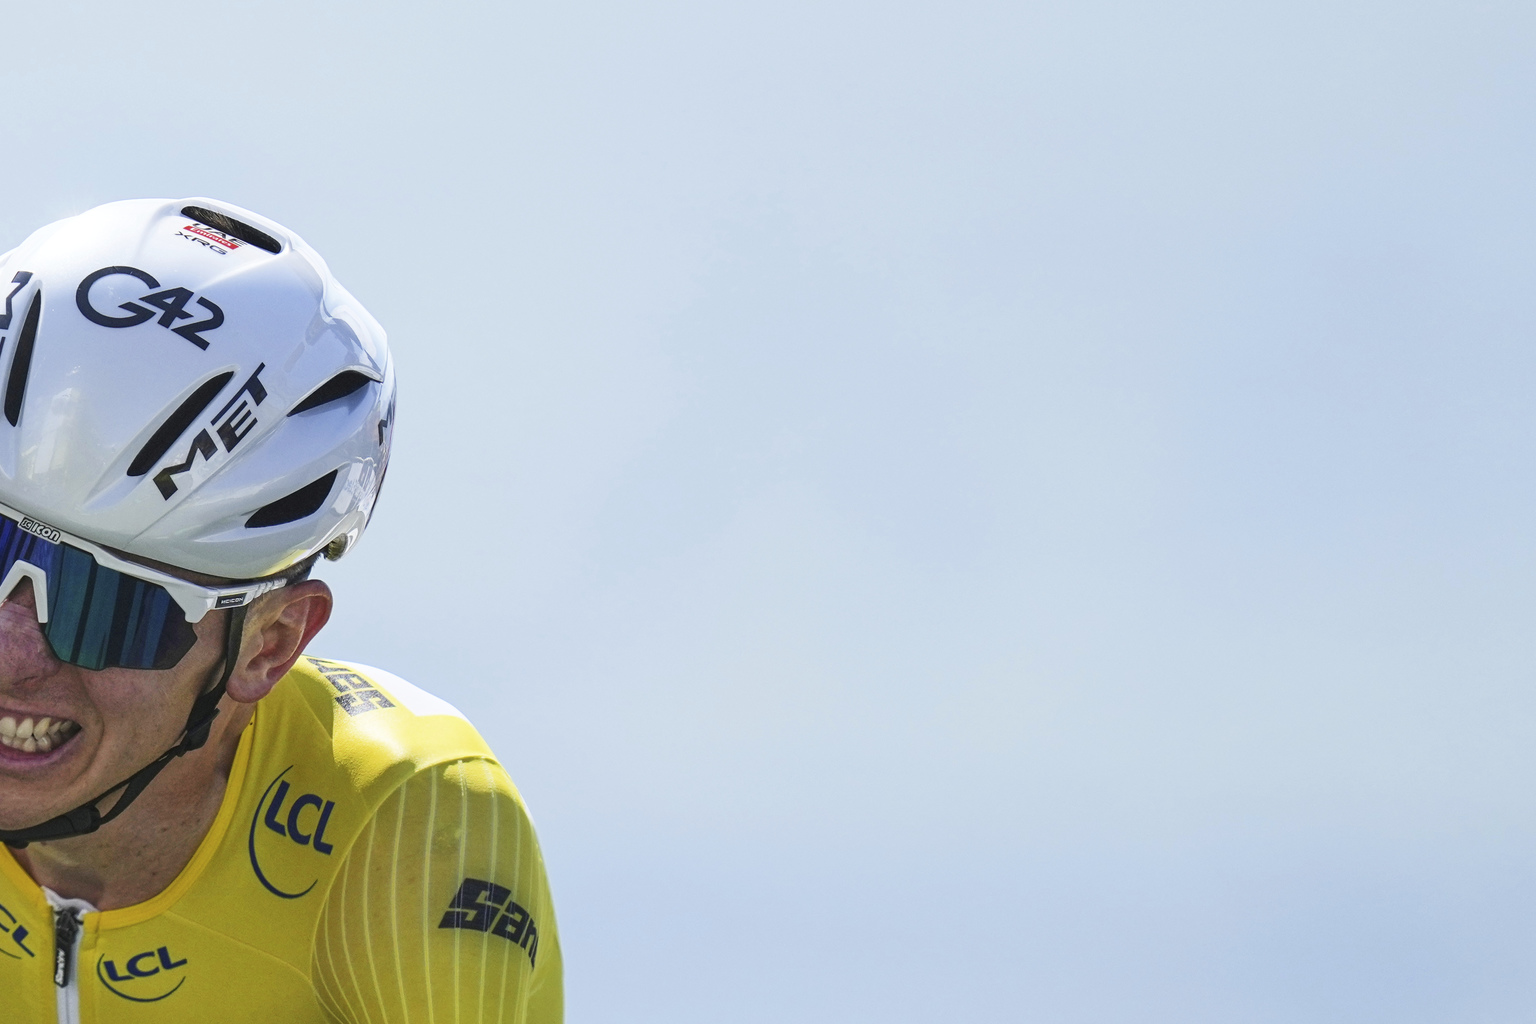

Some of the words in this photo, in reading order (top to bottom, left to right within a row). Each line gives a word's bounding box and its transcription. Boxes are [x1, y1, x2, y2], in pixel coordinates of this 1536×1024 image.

[175, 231, 228, 255] XRG
[190, 227, 233, 247] Emirates
[75, 265, 225, 351] G42
[152, 362, 268, 501] MET
[264, 779, 336, 856] LCL
[103, 945, 188, 983] LCL
